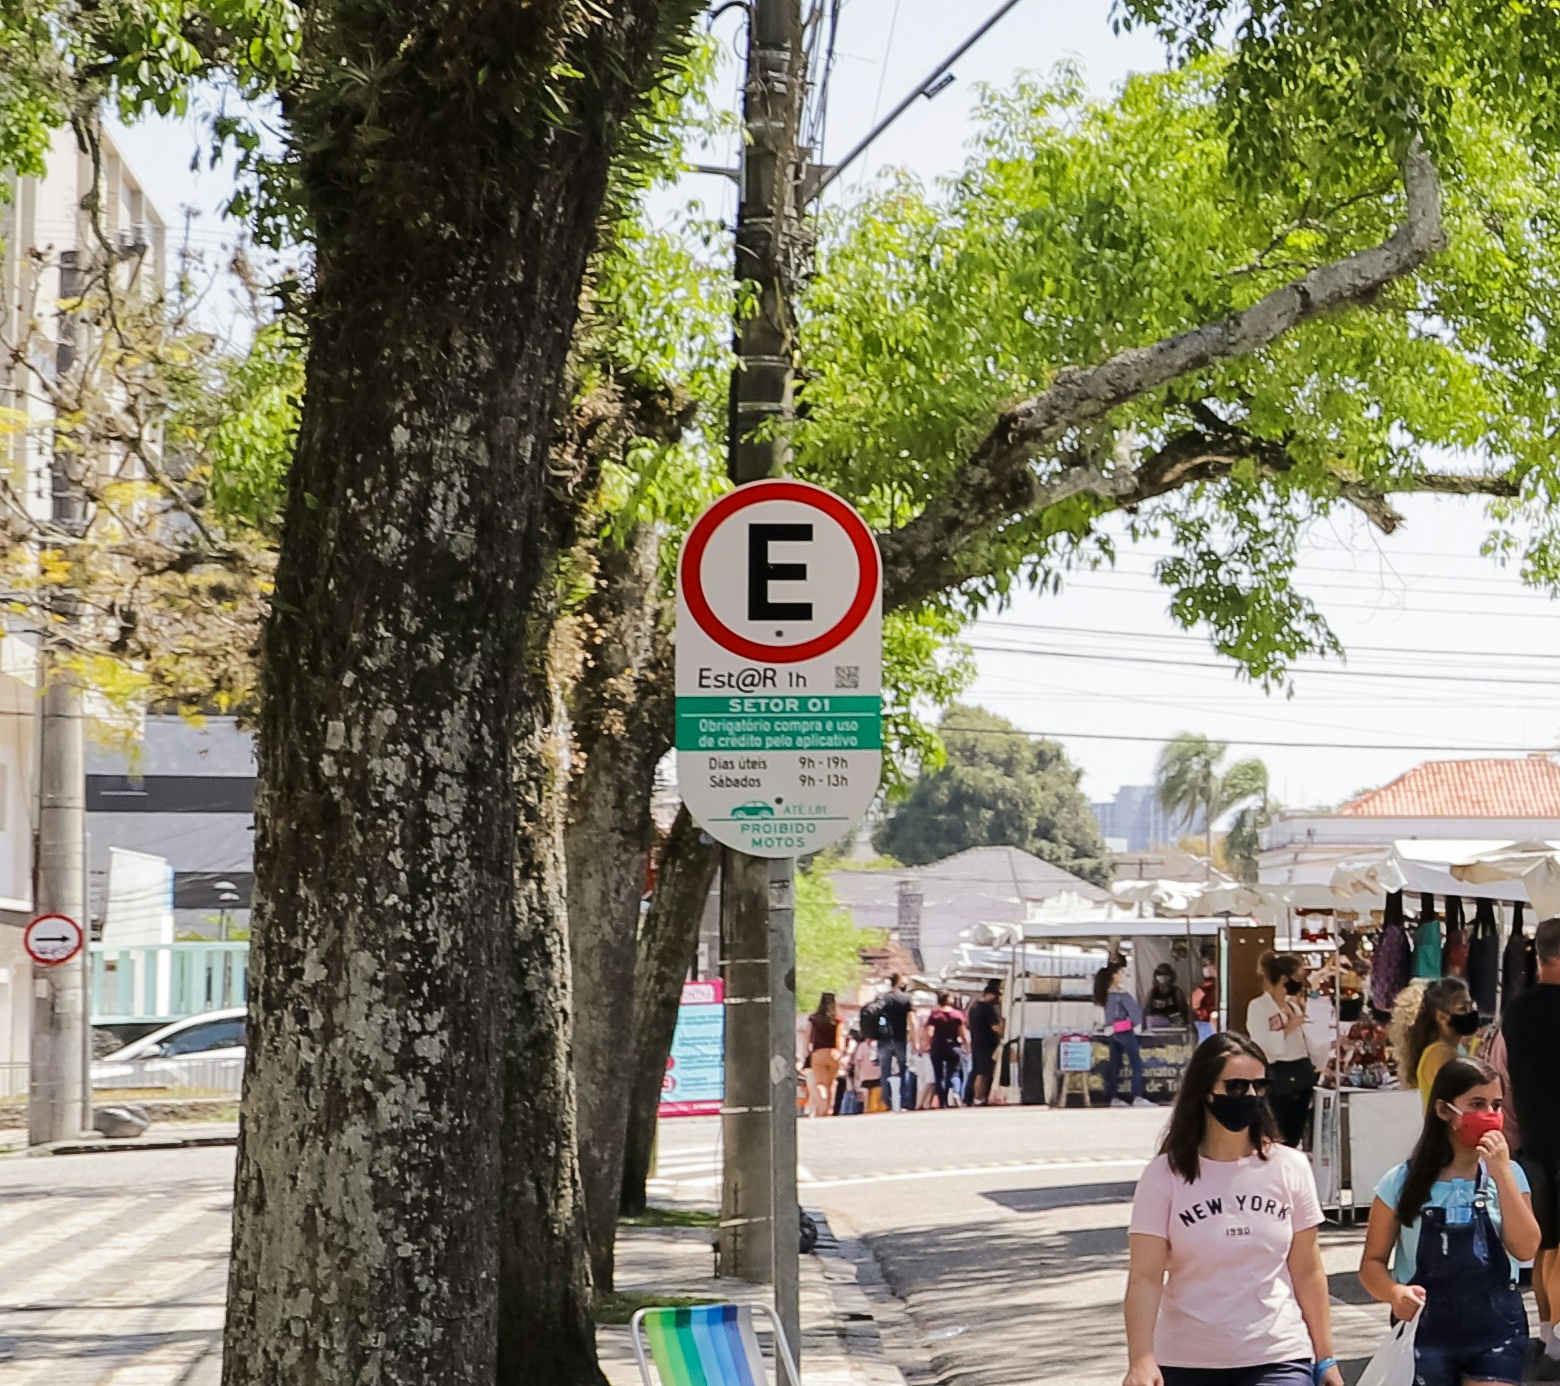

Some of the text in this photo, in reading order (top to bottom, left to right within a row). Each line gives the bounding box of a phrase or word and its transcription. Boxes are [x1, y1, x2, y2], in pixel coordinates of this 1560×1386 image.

[748, 523, 813, 621] E
[698, 667, 807, 693] Est@R 1h
[728, 698, 799, 712] SETOR
[699, 718, 859, 735] Obrigatório compra e uso
[698, 734, 858, 748] de crédito pelo aplicativo
[709, 757, 735, 770] Dias
[738, 756, 767, 770] úteis
[798, 757, 815, 769] 9h
[826, 757, 849, 768] 19h
[709, 774, 761, 788] Sábados
[798, 774, 815, 787] 9h
[826, 774, 849, 787] 13h
[740, 822, 816, 834] PROIBIDO
[751, 837, 806, 848] MOTOS
[1178, 1195, 1291, 1228] NEW YORK
